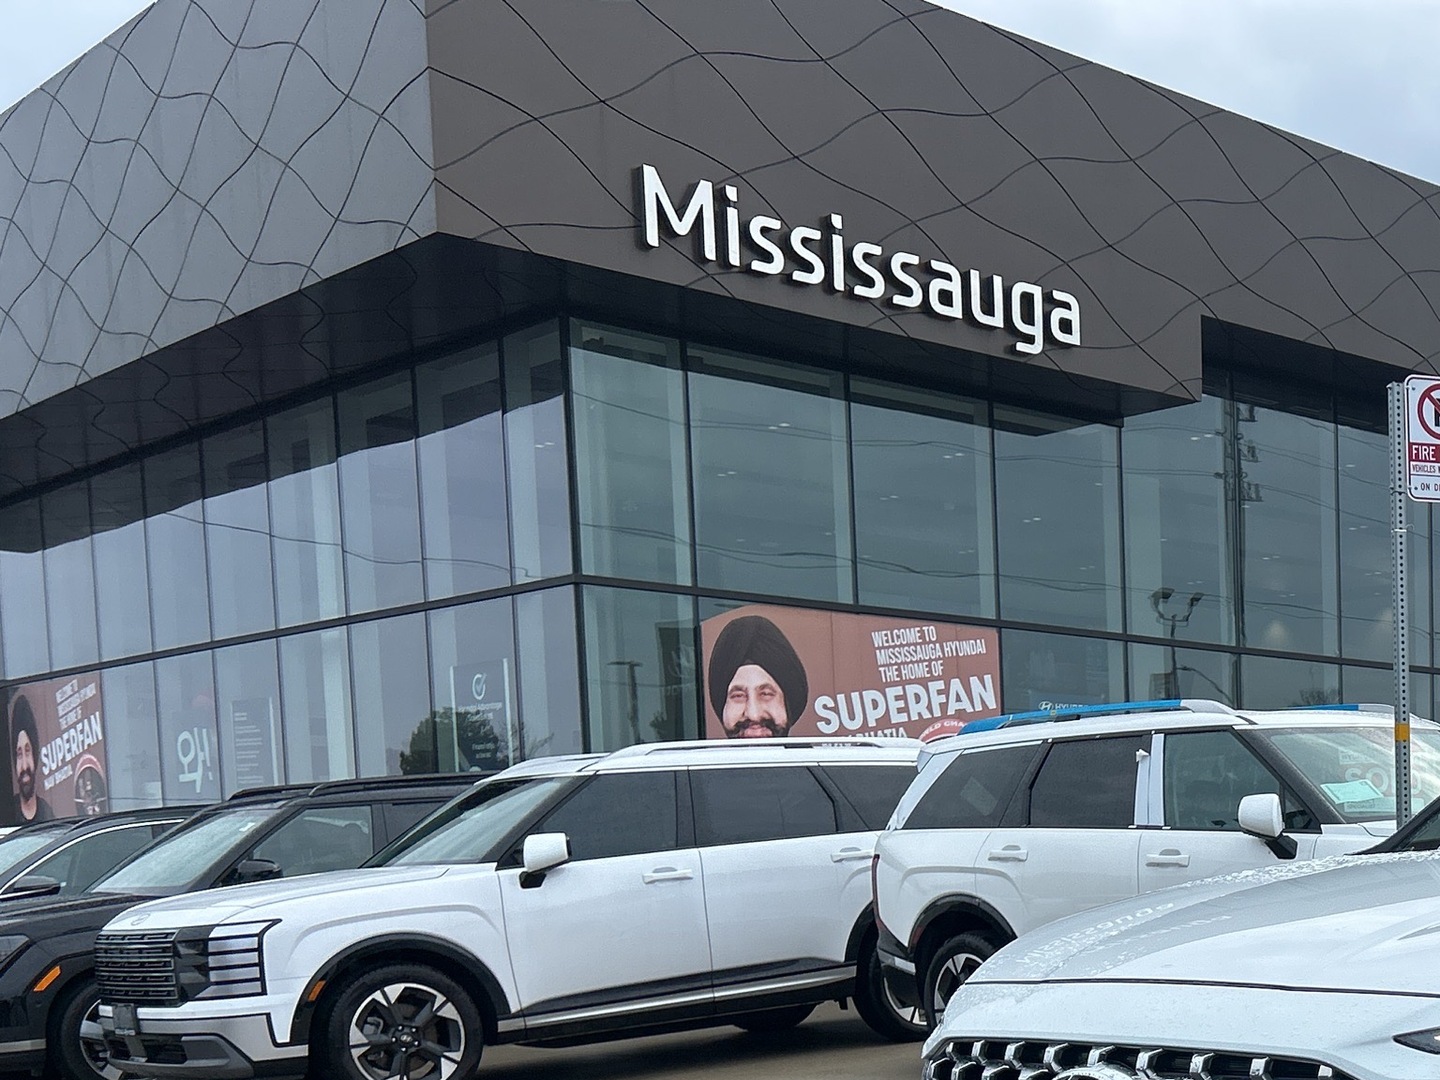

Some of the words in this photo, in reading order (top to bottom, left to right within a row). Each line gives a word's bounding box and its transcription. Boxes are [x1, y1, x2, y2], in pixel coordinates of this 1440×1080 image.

[637, 163, 1082, 354] Mississauga
[1412, 445, 1436, 461] FIRE
[1412, 464, 1436, 473] VEHICLES
[1420, 482, 1430, 491] ON
[871, 628, 922, 648] WELCOME
[923, 625, 937, 642] TO
[875, 643, 942, 666] MISSISSAUGA
[943, 639, 987, 659] HYUNDAI
[879, 665, 900, 683] THE
[901, 662, 930, 679] HOME
[931, 660, 944, 677] OF
[814, 674, 997, 734] SUPERFAN
[40, 711, 103, 776] SUPERFAN
